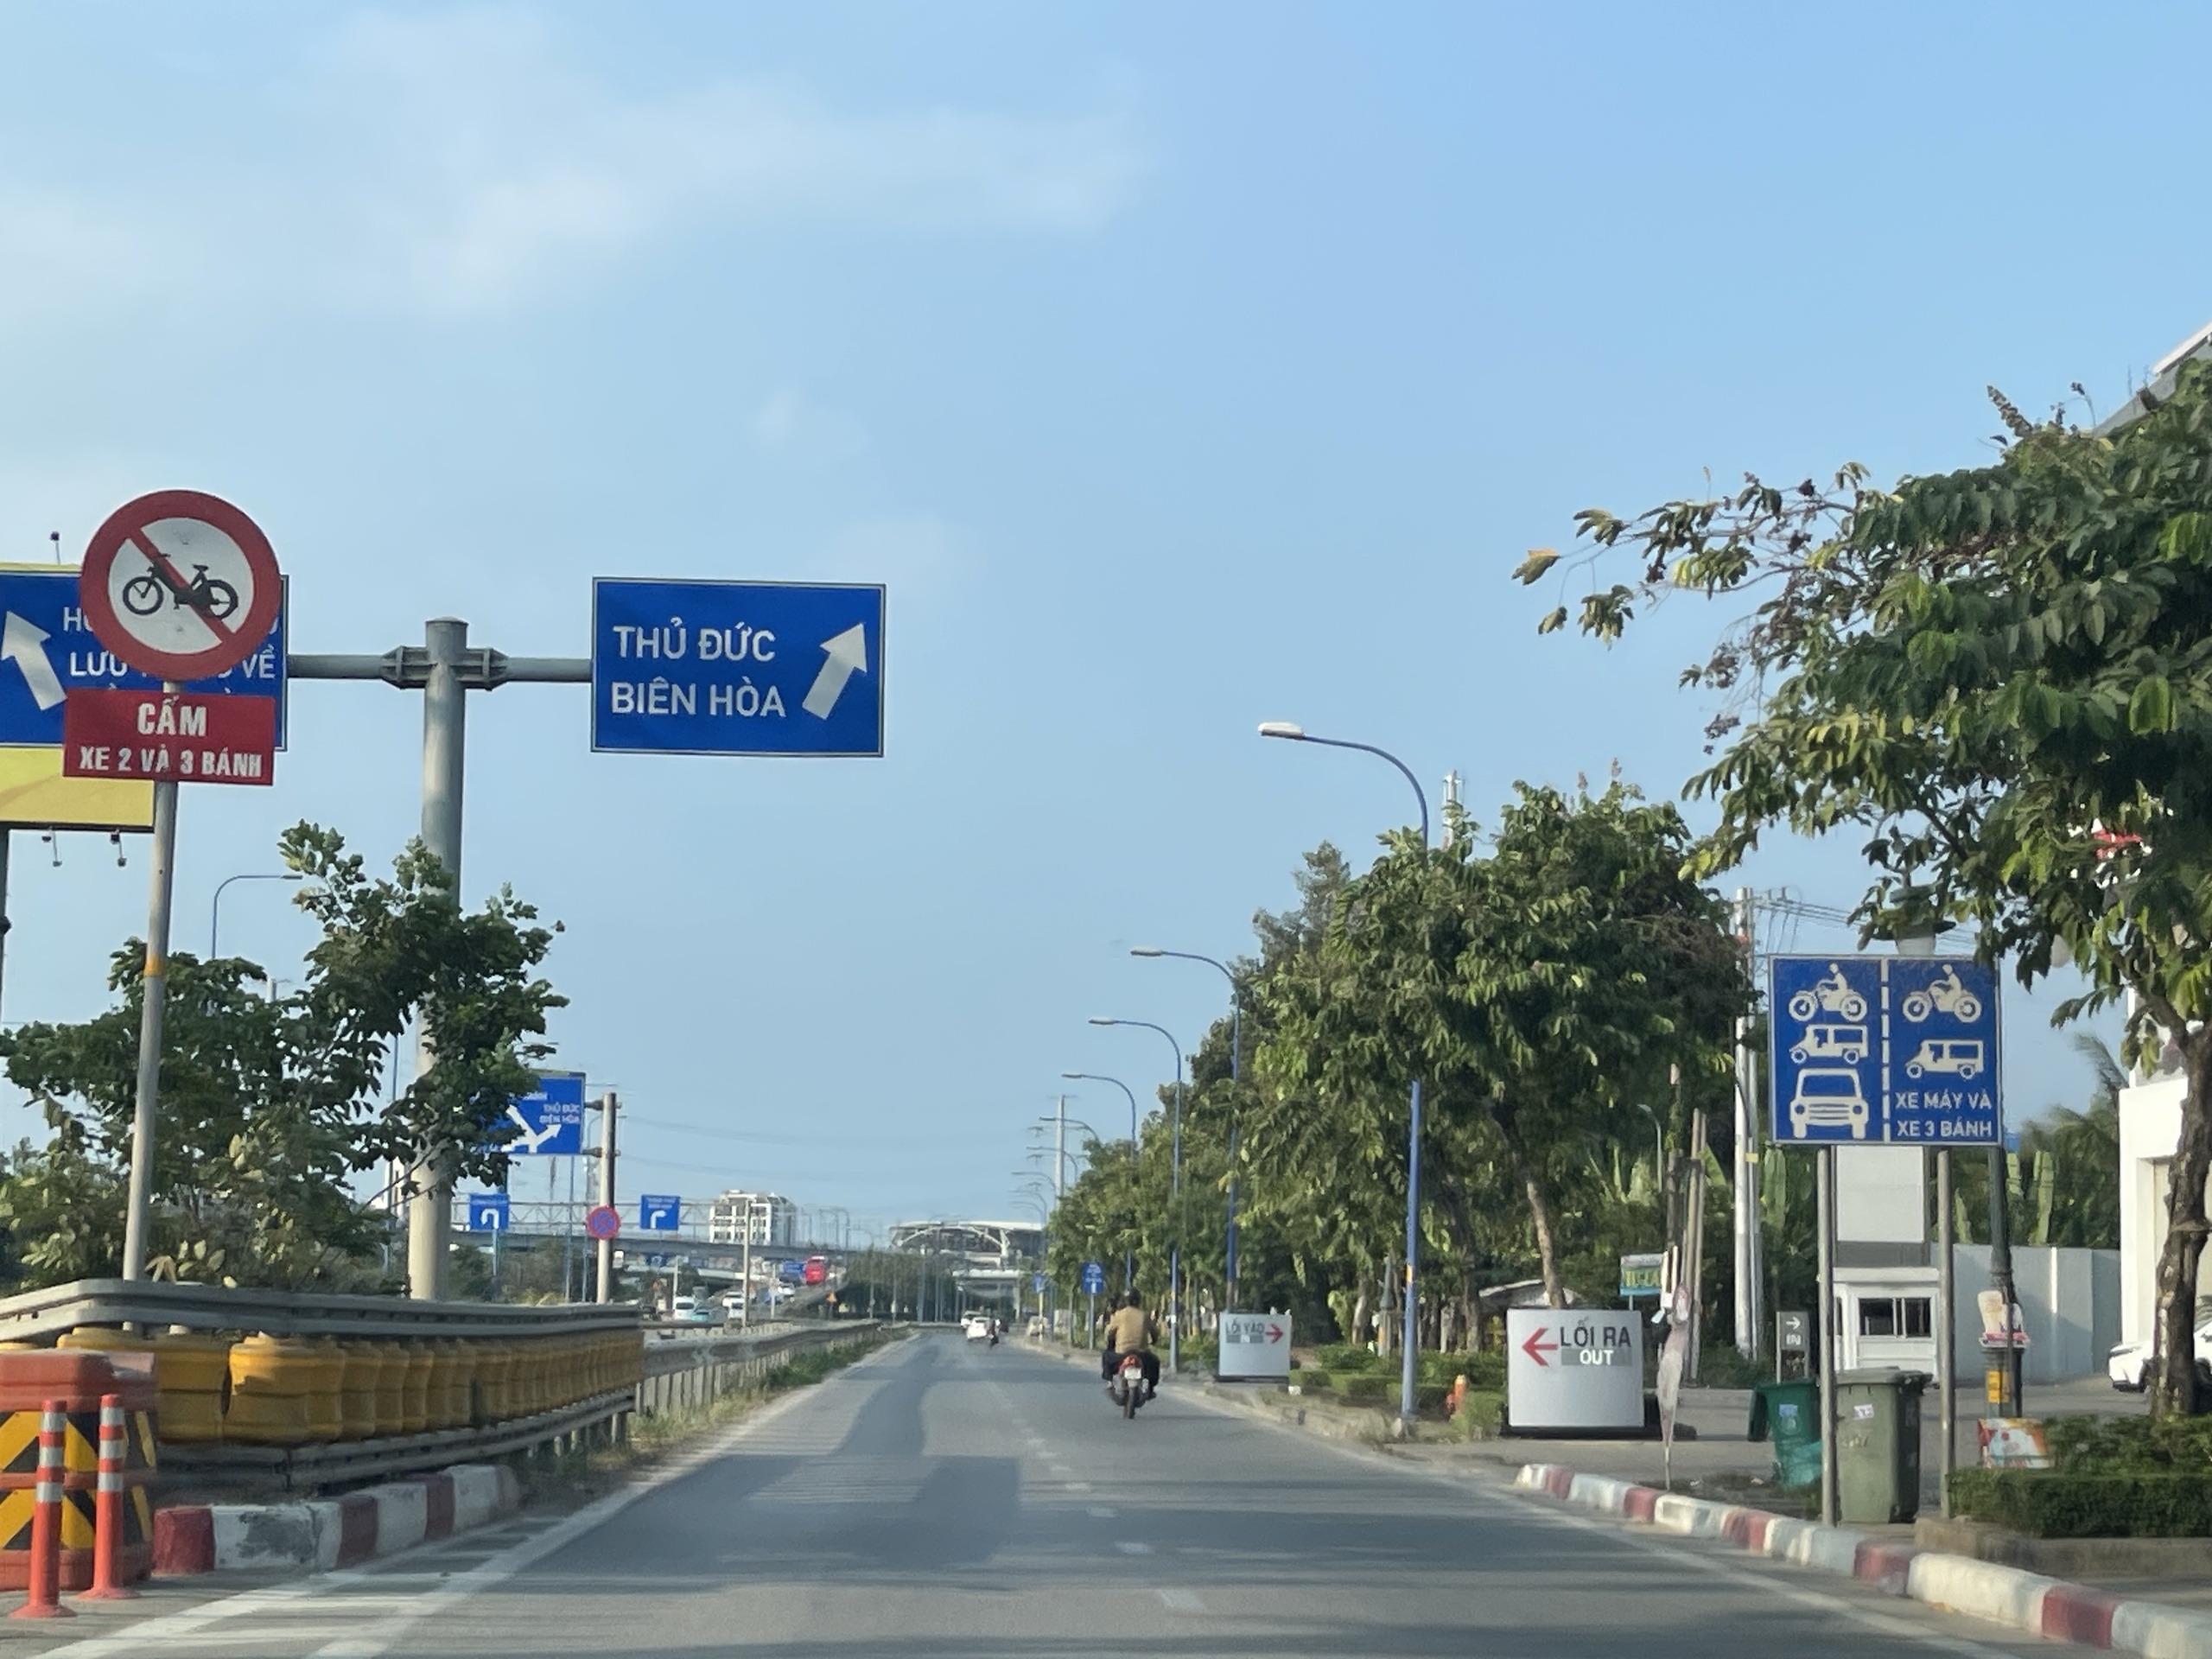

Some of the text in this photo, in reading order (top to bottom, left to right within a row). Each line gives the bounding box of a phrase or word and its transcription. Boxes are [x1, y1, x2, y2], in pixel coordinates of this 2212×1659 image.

[613, 616, 776, 662] THỦ ĐỨC
[242, 643, 276, 678] VỀ
[611, 676, 786, 718] BIÊN HÒA
[137, 695, 207, 736] CẤM
[79, 744, 262, 778] XE 2 VÀ 3 BÁNH
[1895, 1088, 1993, 1109] XE MÁY VÀ
[1897, 1116, 1993, 1137] XE 3 BÁNH
[1560, 1316, 1631, 1347] LỐI RA
[1786, 1333, 1802, 1345] IN
[1580, 1349, 1614, 1365] OUT
